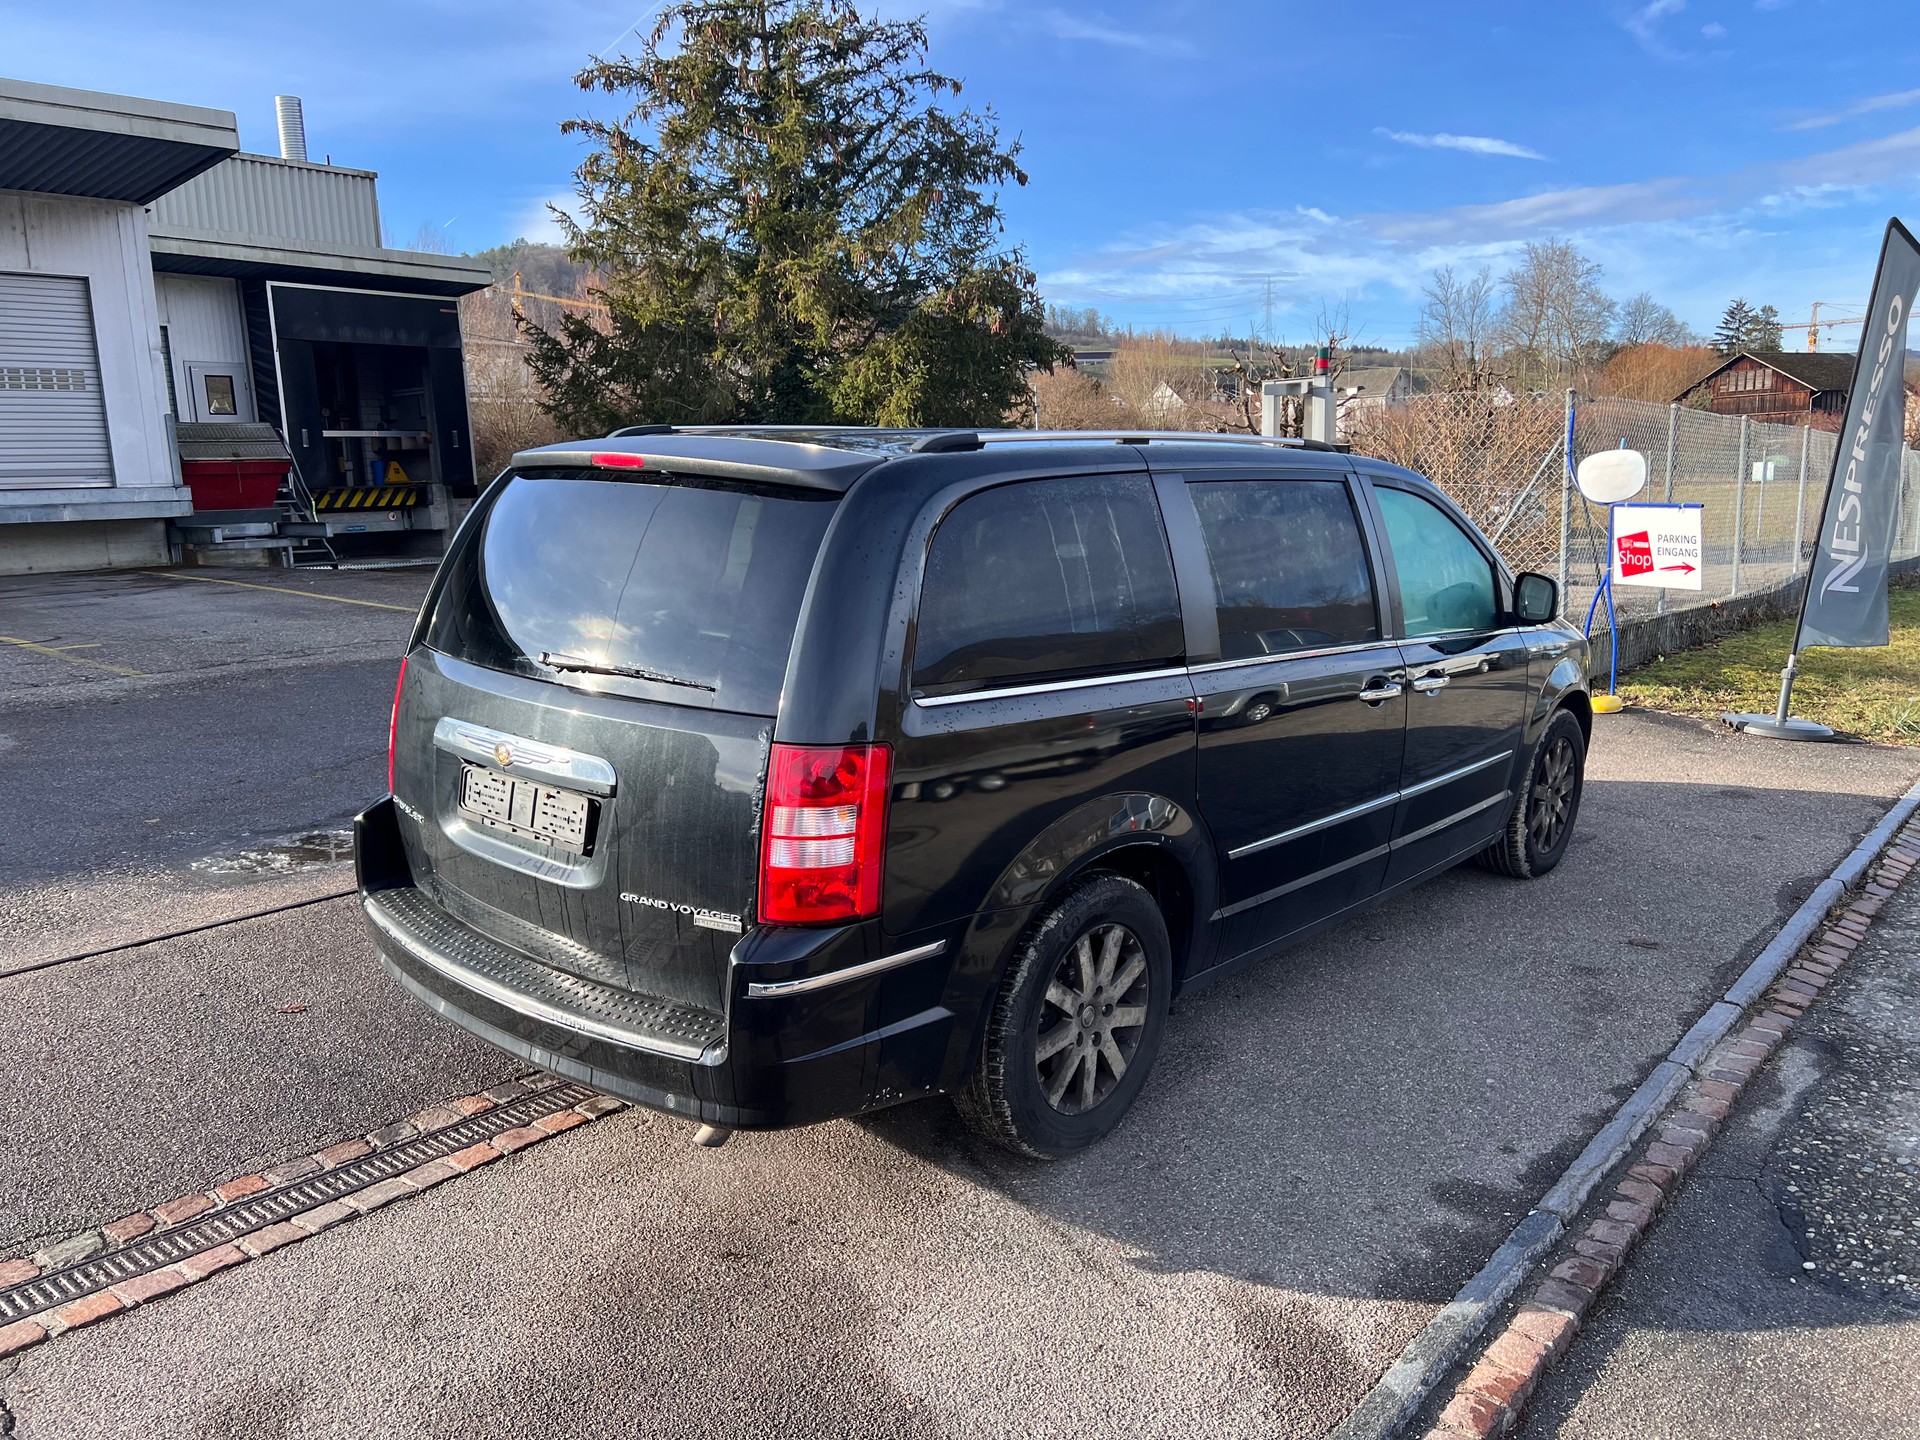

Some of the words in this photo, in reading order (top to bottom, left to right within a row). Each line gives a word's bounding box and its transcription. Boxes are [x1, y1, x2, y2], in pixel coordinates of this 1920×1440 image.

[1820, 294, 1903, 606] NESPRESSO
[1657, 534, 1697, 545] PARKING
[1619, 551, 1651, 569] Shop
[1657, 547, 1698, 558] EINGANG
[620, 892, 668, 909] GRAND
[669, 902, 742, 922] VOYAGER
